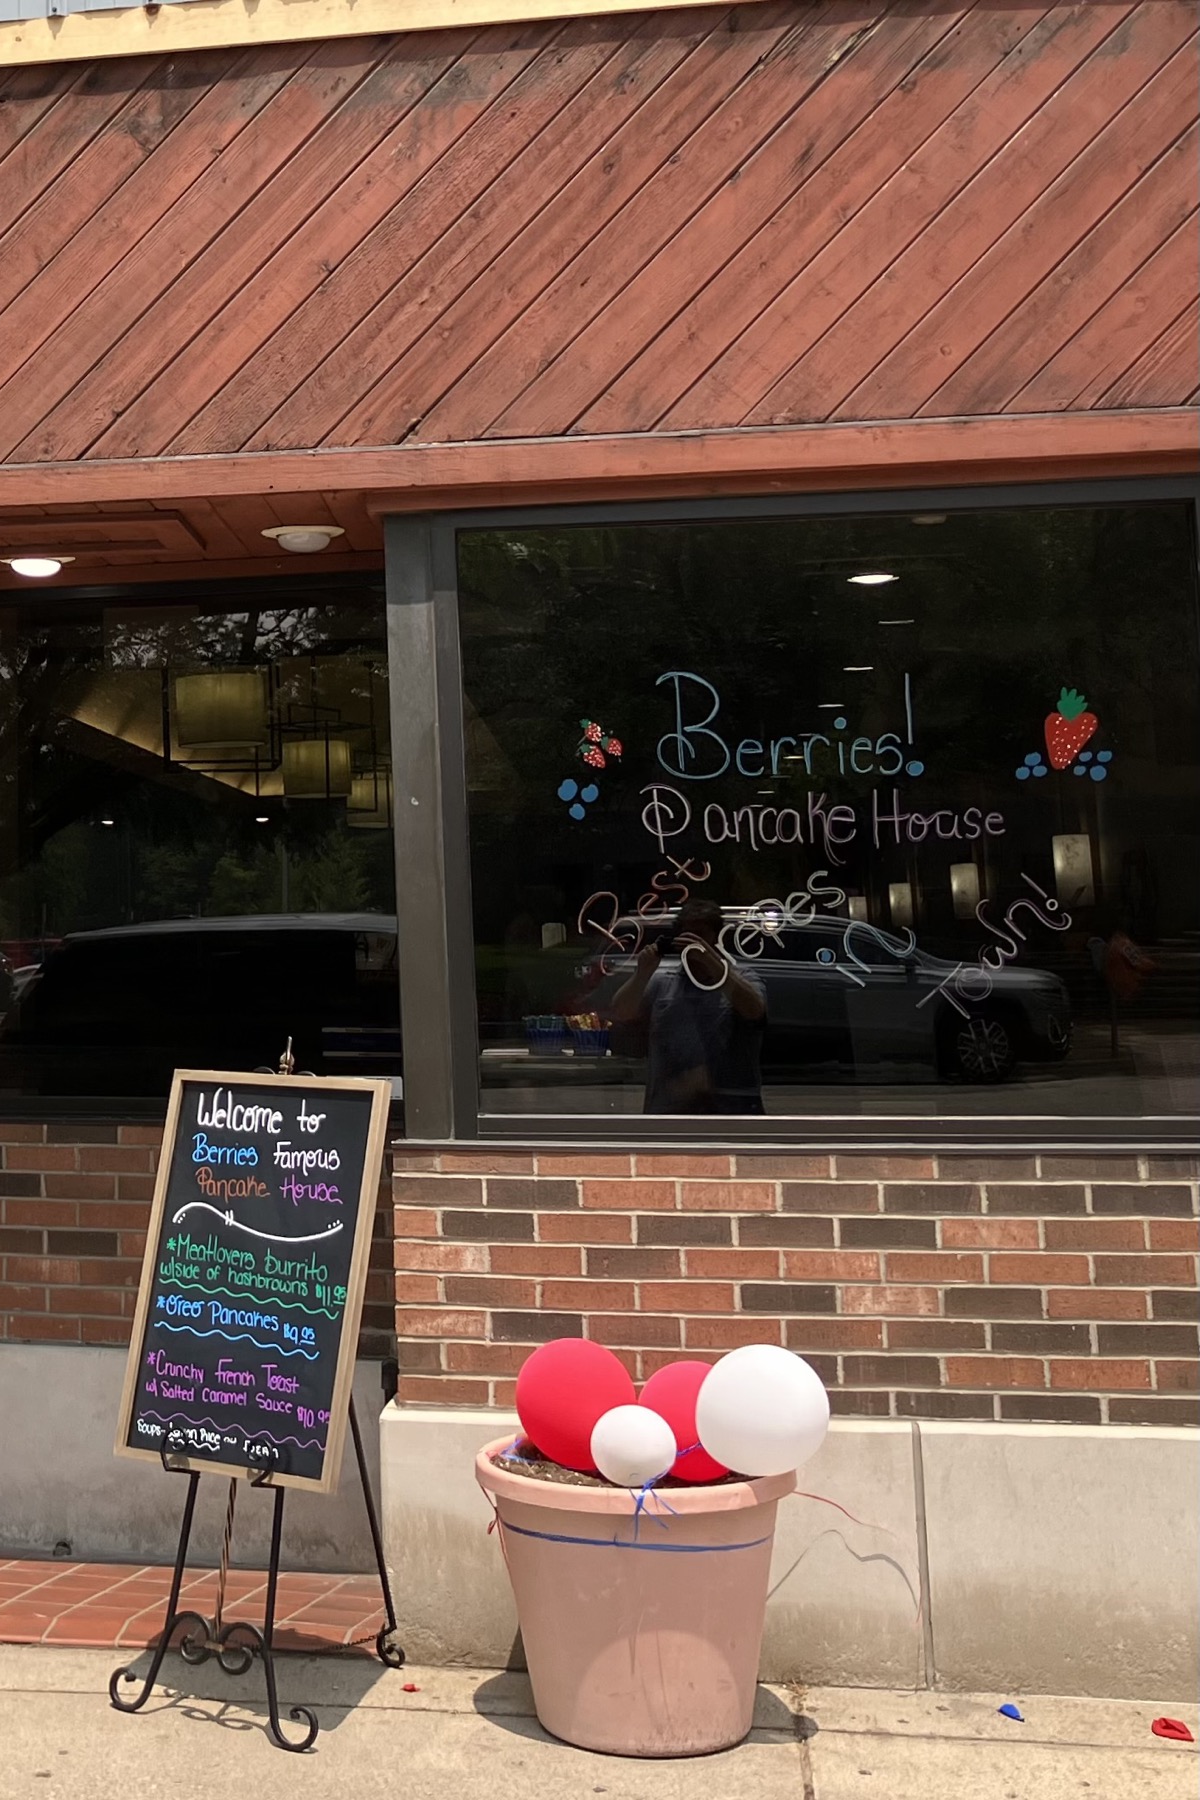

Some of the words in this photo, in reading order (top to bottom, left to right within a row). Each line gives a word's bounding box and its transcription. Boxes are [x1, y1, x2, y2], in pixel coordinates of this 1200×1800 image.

[655, 670, 925, 780] Berries!
[639, 782, 857, 865] Pancake
[873, 787, 1007, 849] House
[577, 854, 711, 977] Best
[681, 870, 846, 991] Crepes
[816, 919, 916, 988] in
[915, 871, 1073, 1019] Town!
[197, 1087, 283, 1134] Welcome
[296, 1099, 327, 1133] to
[192, 1132, 259, 1166] Berries
[273, 1141, 341, 1177] Famous
[195, 1166, 270, 1204] Pancake
[279, 1174, 343, 1207] House
[206, 1266, 221, 1281] of
[228, 1267, 309, 1297] hashbrowns
[207, 1300, 279, 1332] Pancakes
[161, 1379, 194, 1402] Salted
[256, 1392, 293, 1414] Sauce
[215, 1358, 256, 1387] French
[261, 1364, 300, 1394] Toast
